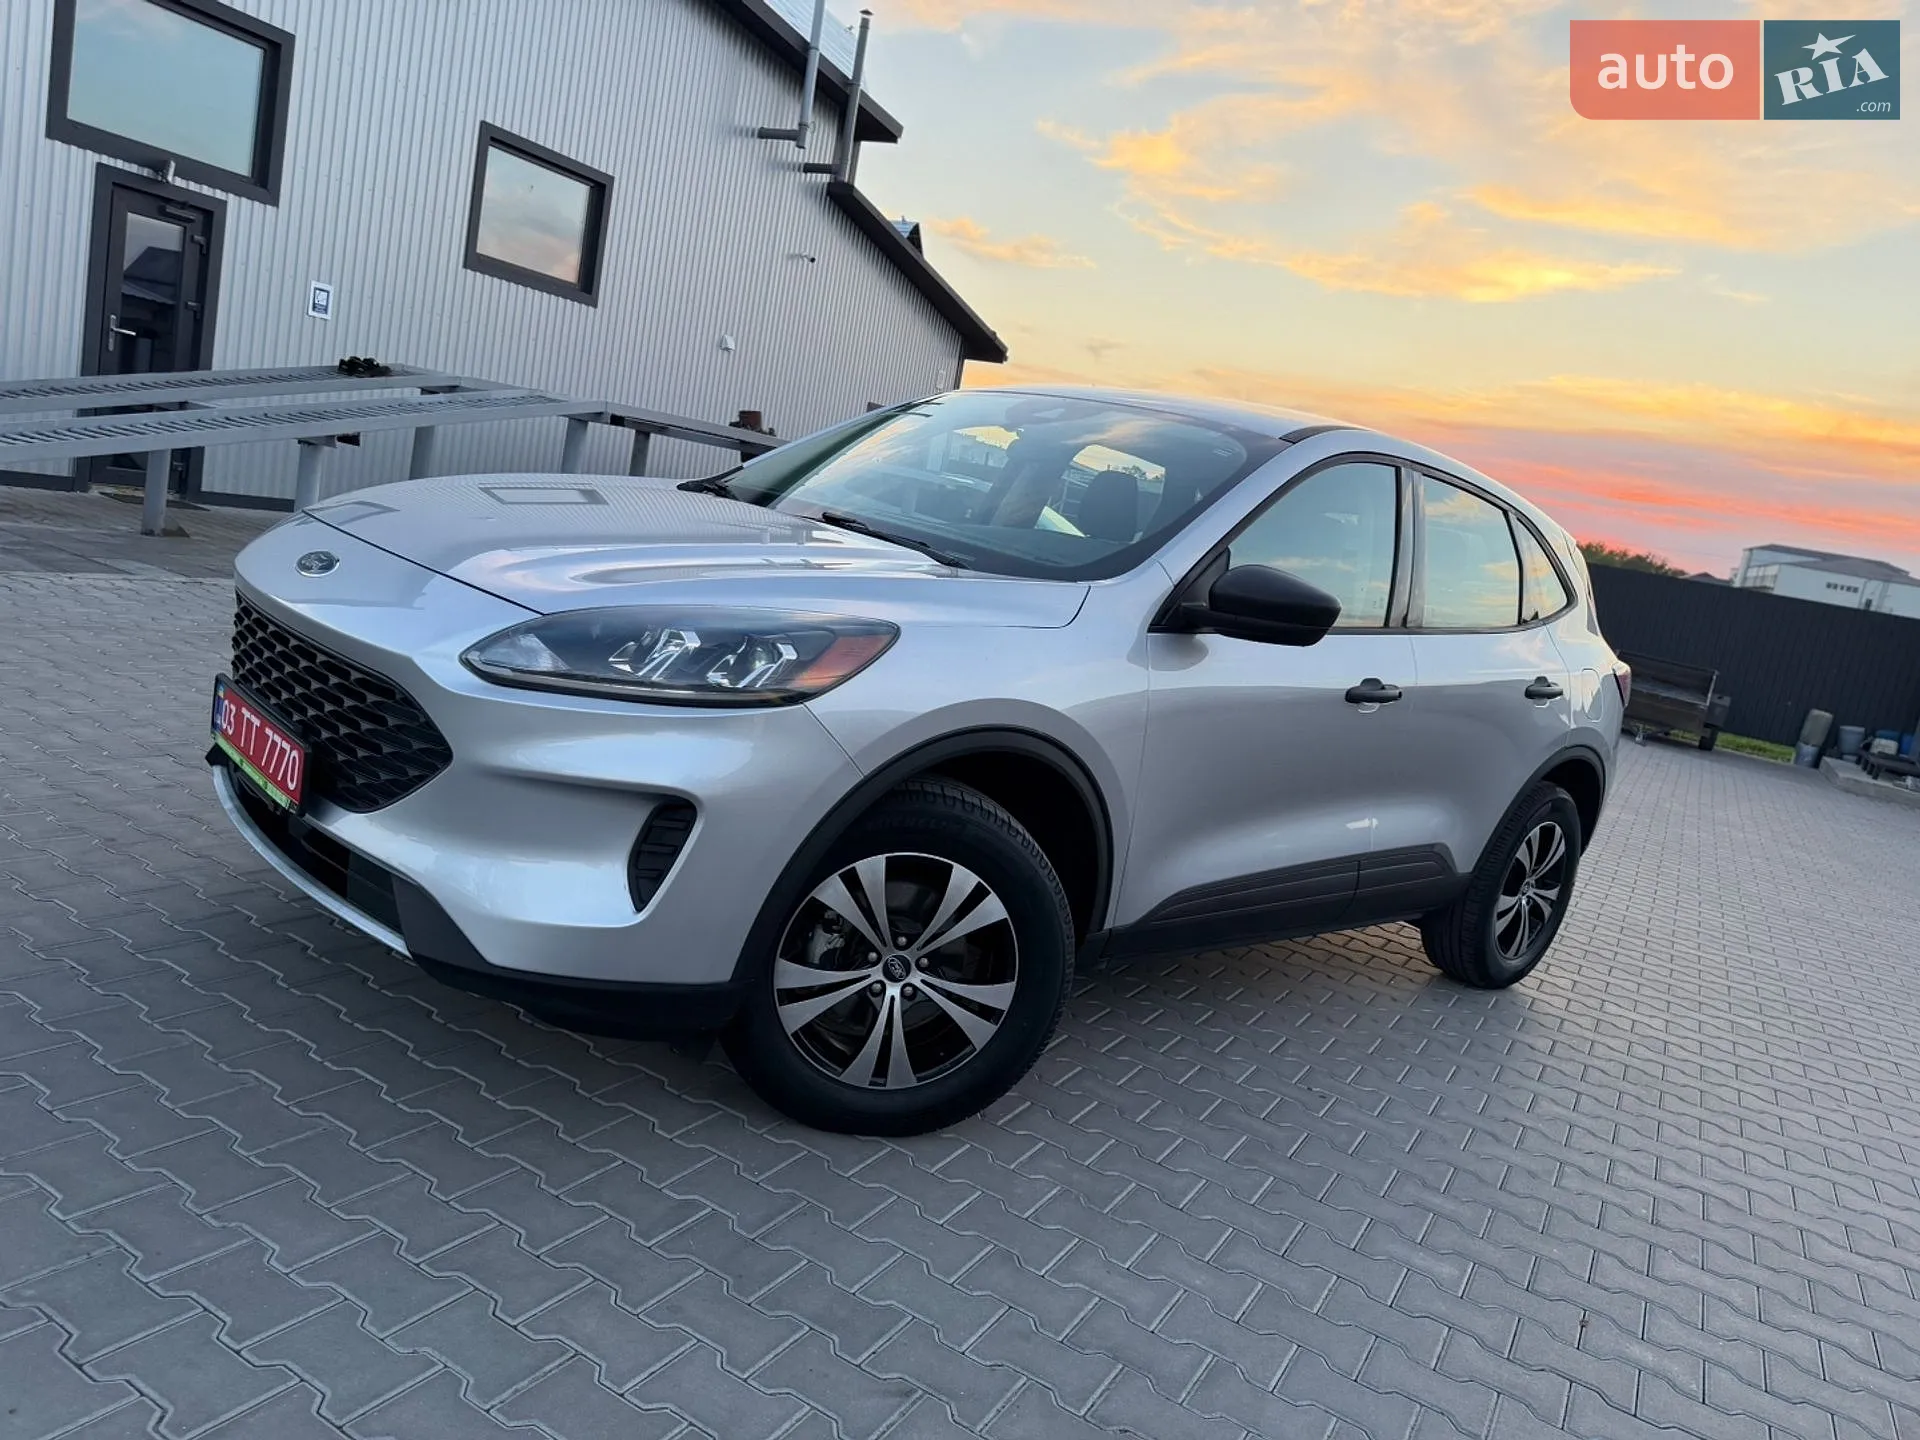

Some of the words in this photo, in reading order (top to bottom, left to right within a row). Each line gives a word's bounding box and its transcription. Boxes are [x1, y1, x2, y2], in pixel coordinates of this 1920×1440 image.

[221, 699, 236, 736] 03
[241, 707, 261, 756] TT
[261, 727, 300, 791] 7770
